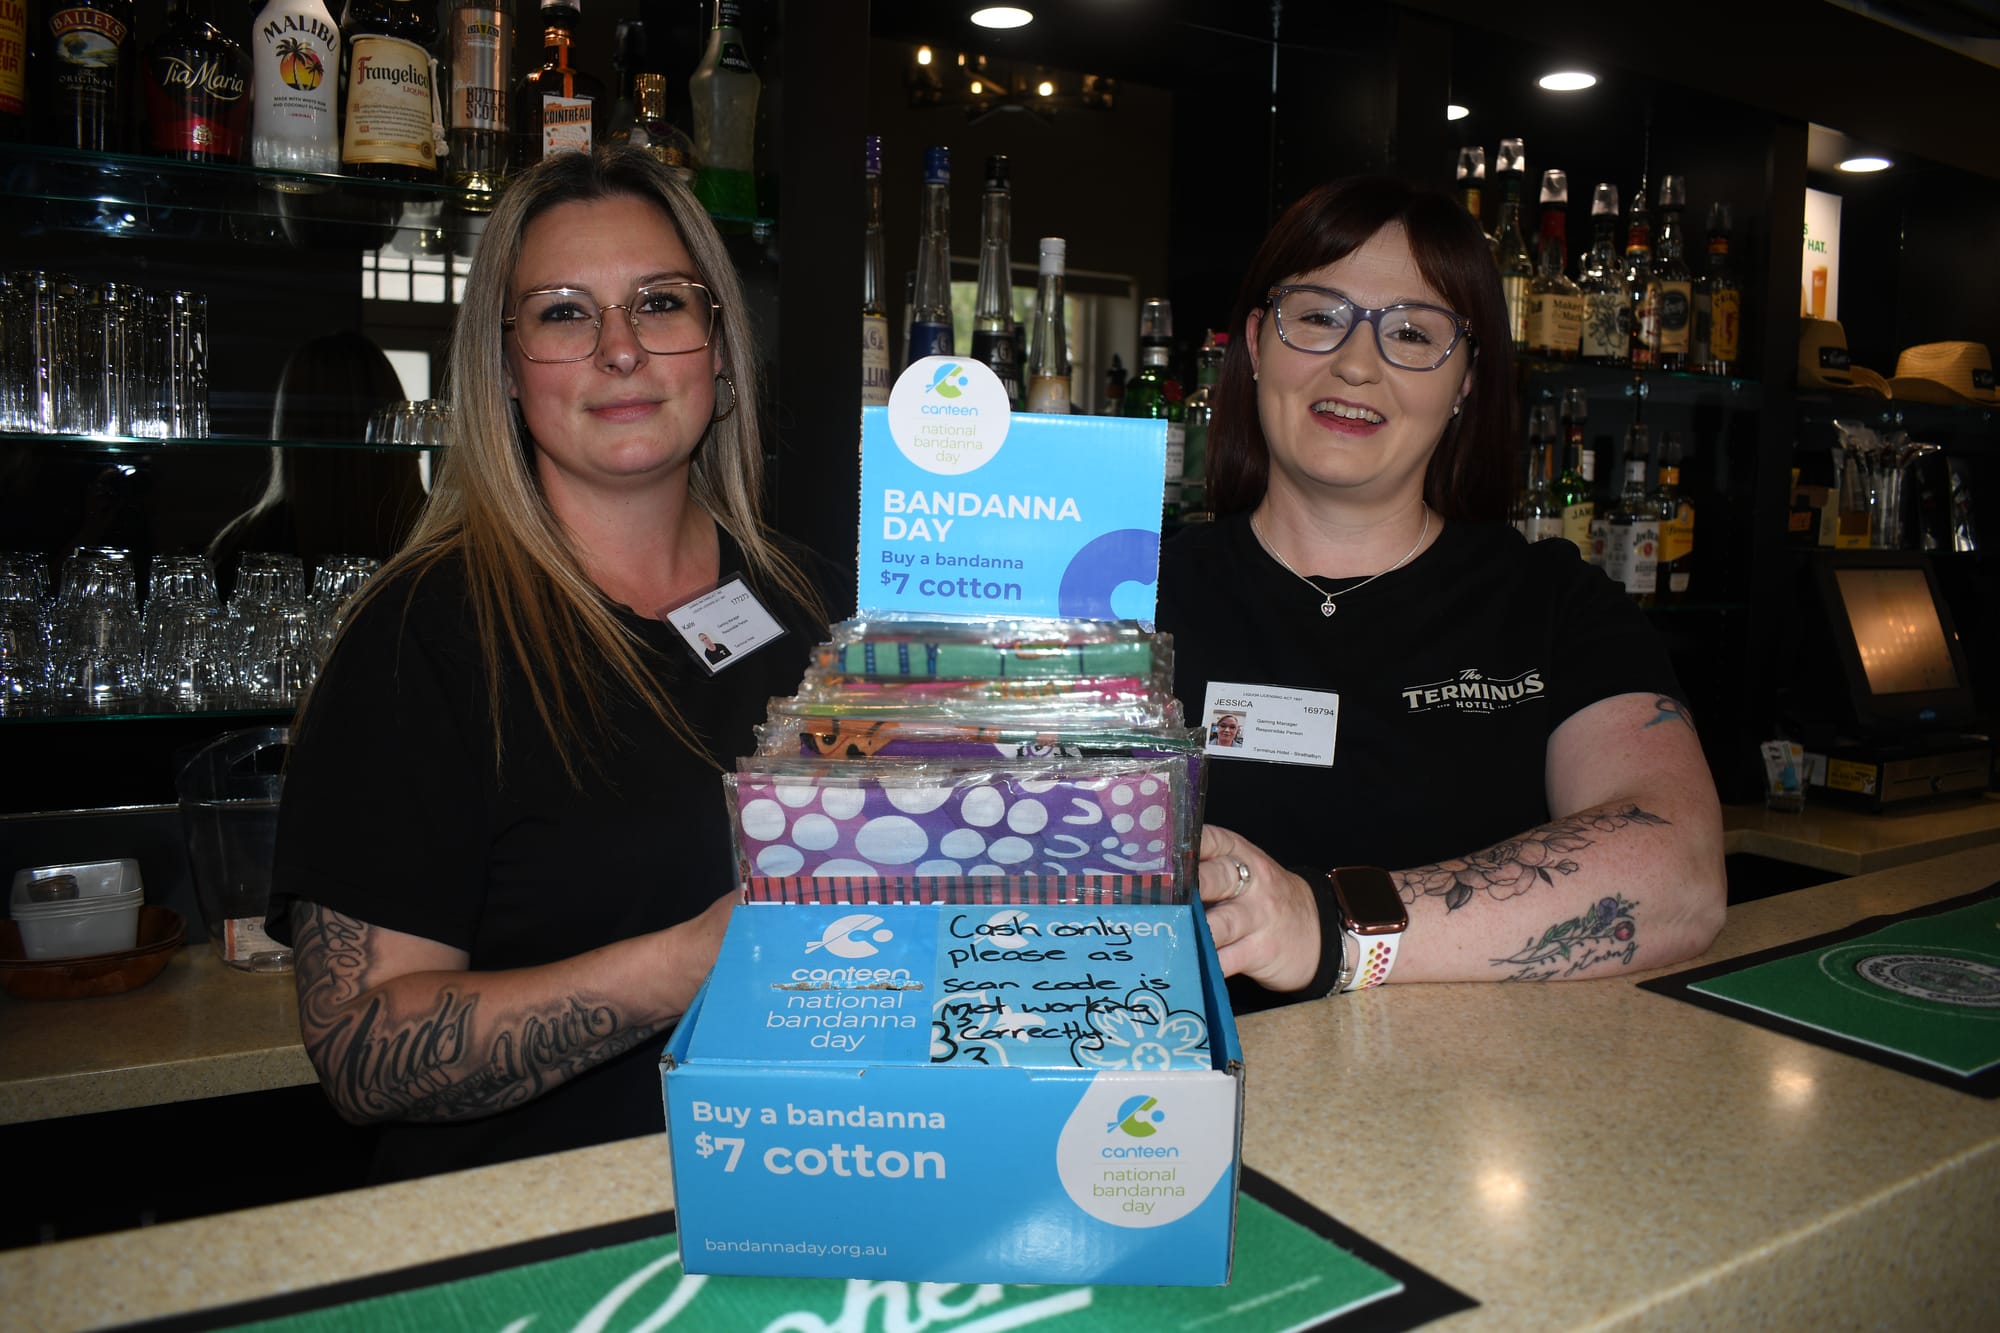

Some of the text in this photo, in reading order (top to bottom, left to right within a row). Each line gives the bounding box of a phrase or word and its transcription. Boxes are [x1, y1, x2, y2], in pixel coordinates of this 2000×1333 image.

[54, 11, 122, 37] BAILEYS
[263, 15, 337, 52] MALIBU
[159, 56, 245, 100] Tia Maria
[357, 56, 429, 87] Frangelico
[544, 107, 591, 125] COINTREAU
[921, 403, 978, 417] canteen
[922, 423, 976, 436] national
[914, 436, 983, 450] bandanna
[935, 449, 961, 465] day
[884, 489, 1082, 522] BANDANNA
[883, 516, 954, 543] DAY
[881, 550, 1024, 570] Buy a bandanna
[880, 570, 1022, 601] $7 cotton
[1459, 668, 1483, 681] The
[1402, 673, 1545, 709] TERMINUS
[1214, 698, 1253, 708] JESSICA
[1303, 706, 1334, 717] 169794
[1456, 700, 1495, 710] HOTEL
[1256, 718, 1298, 728] Gaming Manager
[950, 914, 1132, 946] Cash only
[948, 944, 1134, 969] please as
[1564, 941, 1639, 978] strong
[791, 966, 911, 982] canteen
[943, 973, 1171, 993] scan code is
[787, 992, 903, 1009] national
[766, 1011, 917, 1029] bandanna
[949, 996, 1160, 1026] not working
[810, 1031, 865, 1053] day
[692, 1100, 946, 1129] Buy a bandanna
[695, 1131, 946, 1180] $7 cotton
[1101, 1145, 1179, 1159] canteen
[1103, 1167, 1176, 1181] national
[1093, 1183, 1185, 1198] bandanna
[1122, 1199, 1156, 1216] day
[705, 1237, 887, 1258] bandannaday.org.au
